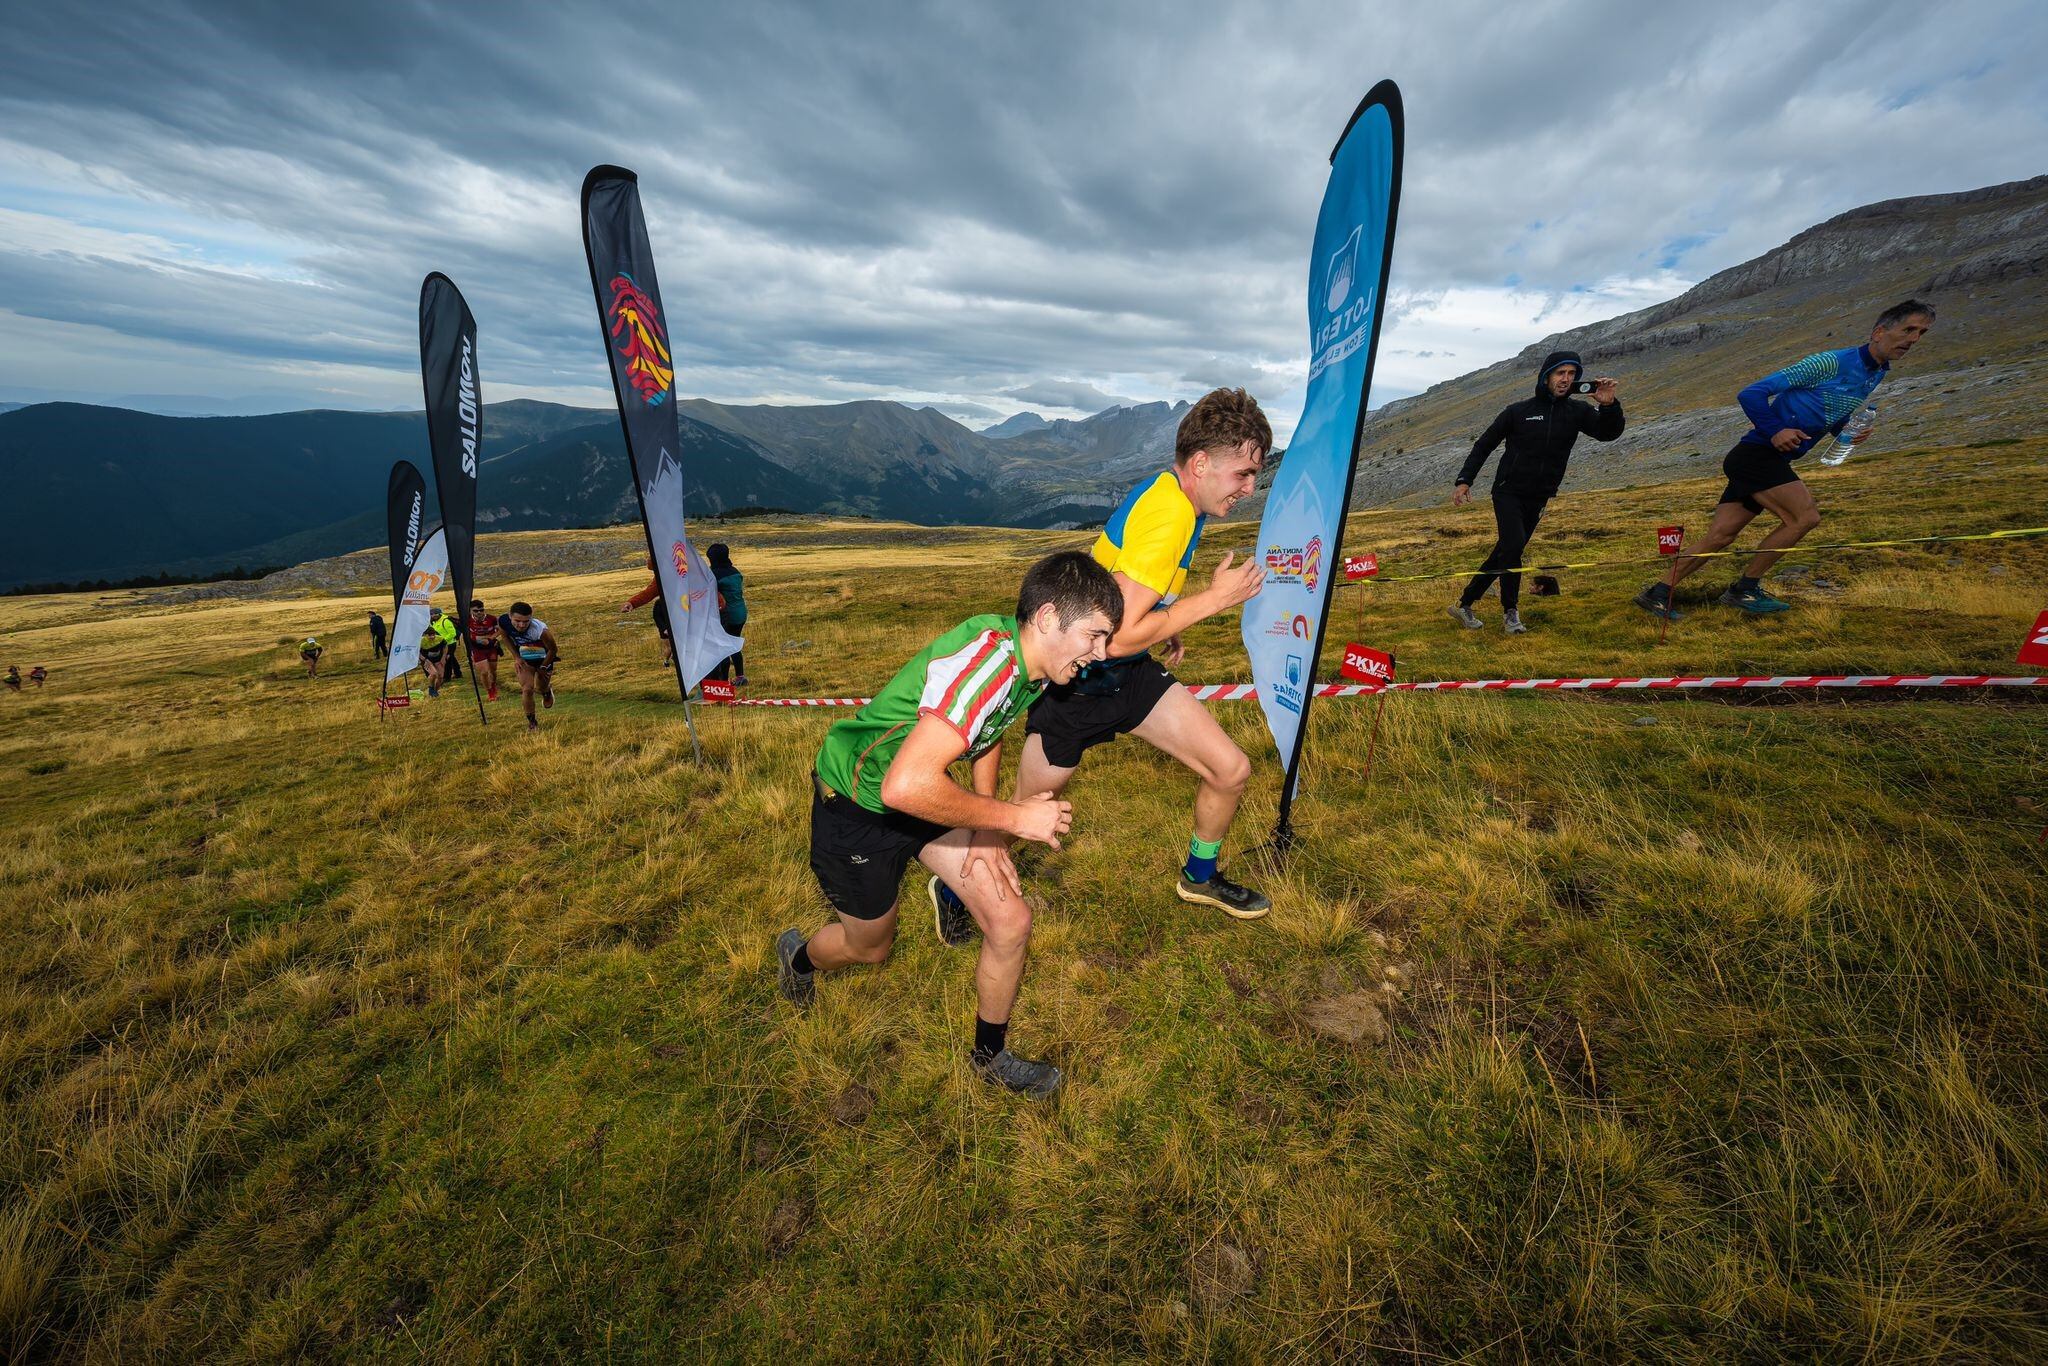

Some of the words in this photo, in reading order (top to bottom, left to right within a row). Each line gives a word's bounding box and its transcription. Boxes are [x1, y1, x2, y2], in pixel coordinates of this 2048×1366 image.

[459, 335, 477, 479] SALOMON
[403, 490, 422, 568] SALOMON
[1659, 534, 1681, 545] 2KV
[1346, 561, 1368, 573] 2KV
[1345, 652, 1381, 673] 2KV
[704, 685, 726, 694] 2KV
